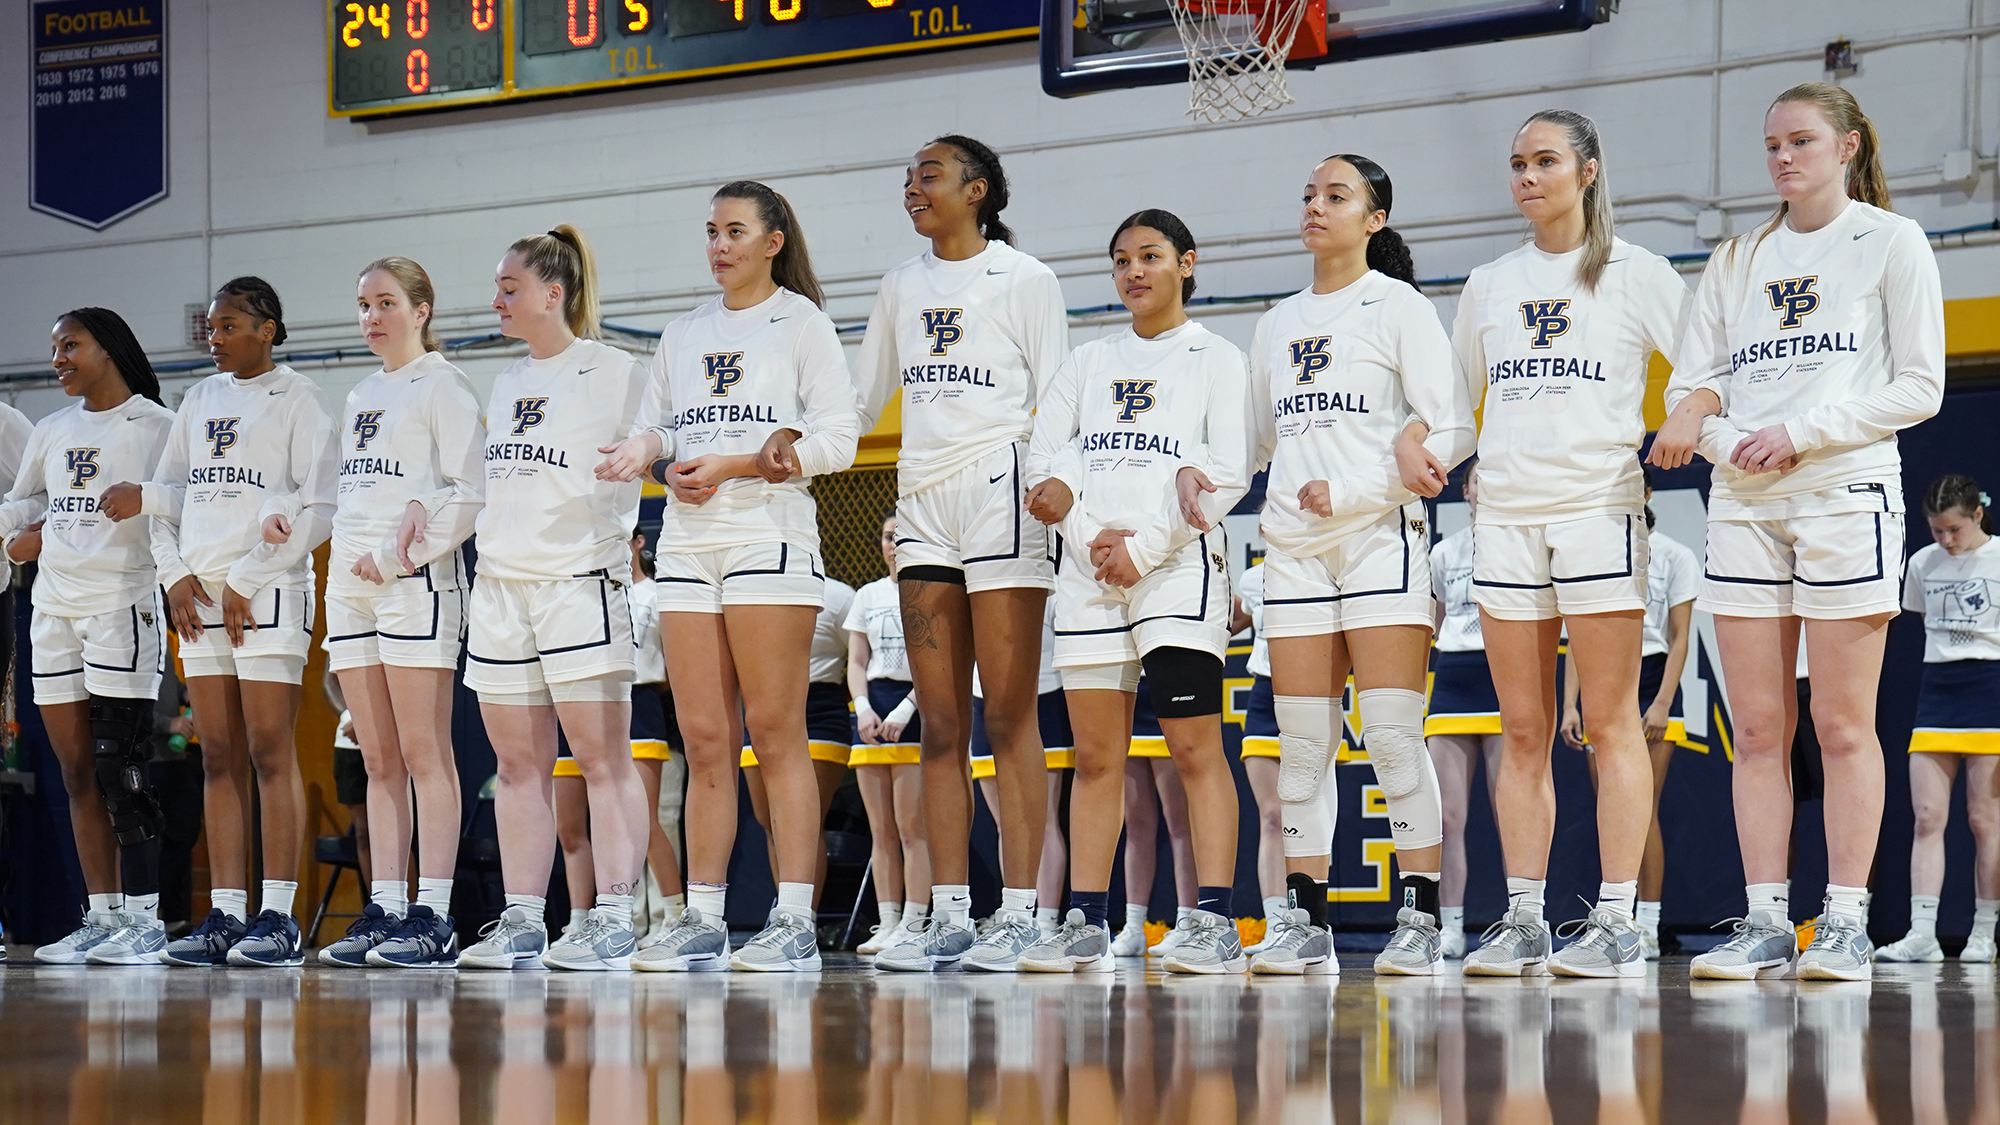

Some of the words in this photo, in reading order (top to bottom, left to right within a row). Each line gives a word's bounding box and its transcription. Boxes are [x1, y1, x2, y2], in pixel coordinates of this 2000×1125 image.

[45, 8, 151, 35] FOOTBALL
[342, 2, 390, 48] 24
[909, 5, 971, 36] T.O.L.
[39, 46, 91, 63] CONFERENCE
[91, 39, 158, 58] CHAMPIONSHIPS
[608, 46, 664, 73] T.O.L.
[37, 71, 62, 86] 1930
[67, 68, 94, 83] 1972
[100, 64, 126, 80] 1975
[132, 61, 159, 76] 1976
[406, 48, 429, 93] 0
[36, 91, 62, 106] 2010
[67, 87, 94, 103] 2012
[100, 84, 127, 100] 2016
